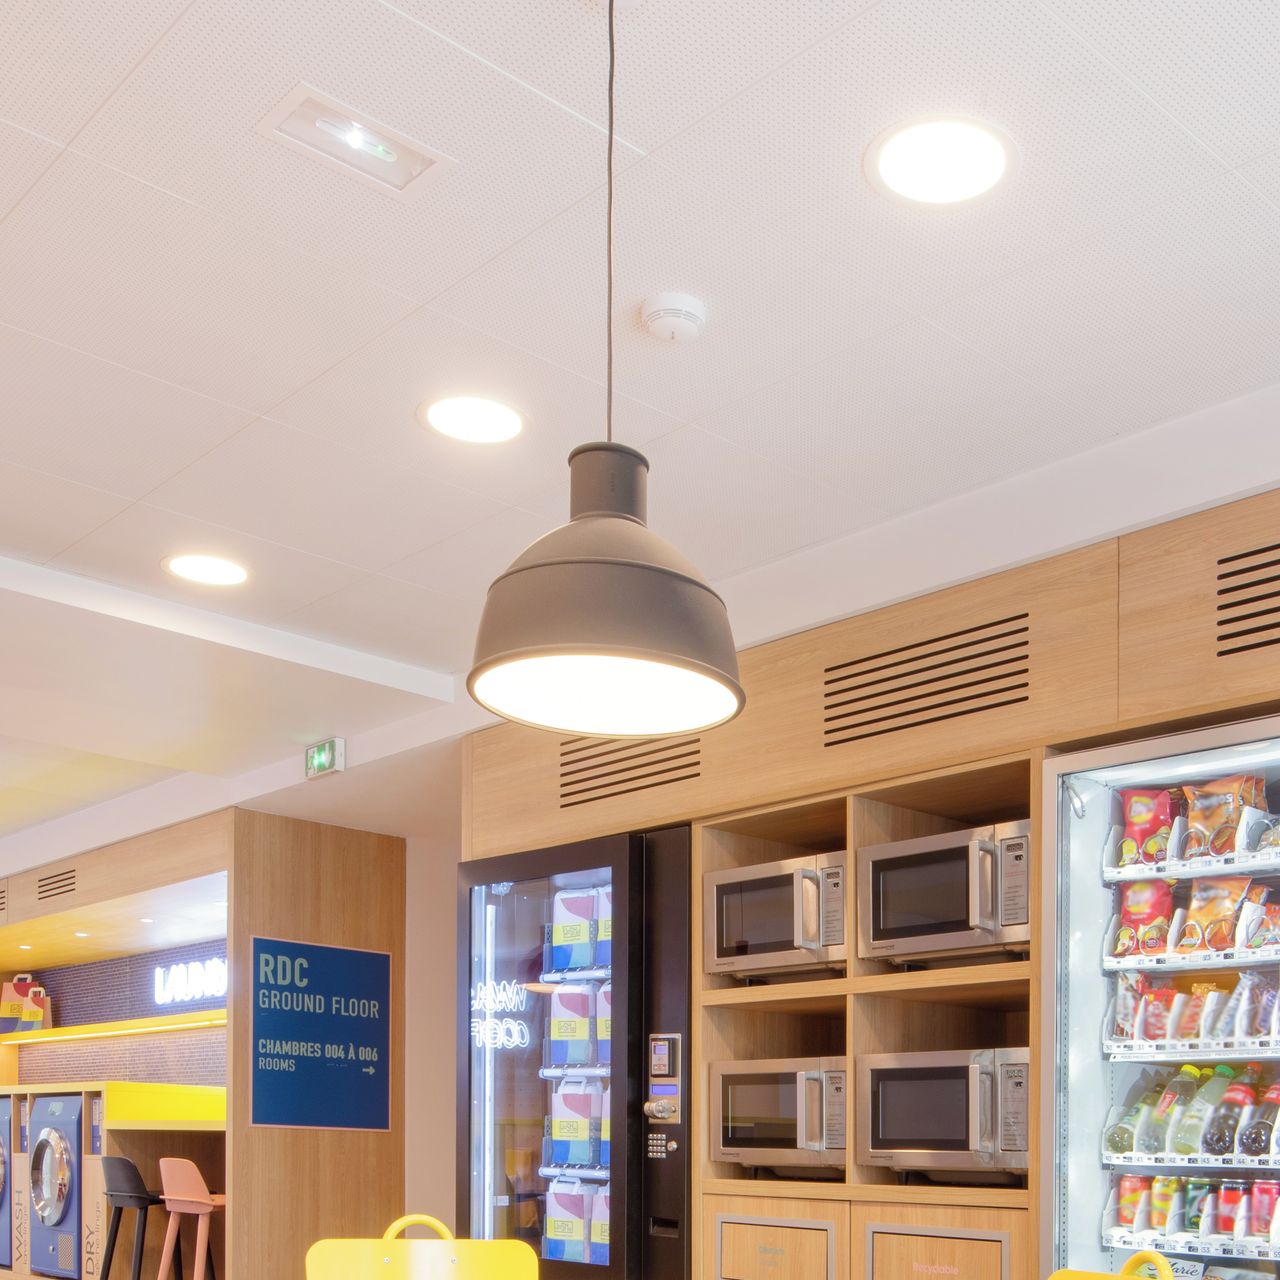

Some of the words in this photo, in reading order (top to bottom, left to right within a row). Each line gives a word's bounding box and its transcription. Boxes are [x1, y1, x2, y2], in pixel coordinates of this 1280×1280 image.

[259, 953, 309, 988] RDC
[259, 989, 325, 1014] GROUND
[332, 997, 380, 1018] FLOOR
[258, 1038, 321, 1057] CHAMBRES
[325, 1044, 345, 1059] 004
[348, 1042, 356, 1060] À
[358, 1046, 378, 1061] 006
[258, 1057, 296, 1072] ROOMS
[15, 1189, 23, 1262] WASH
[85, 1224, 95, 1276] DRY
[912, 1262, 960, 1275] Recyclable
